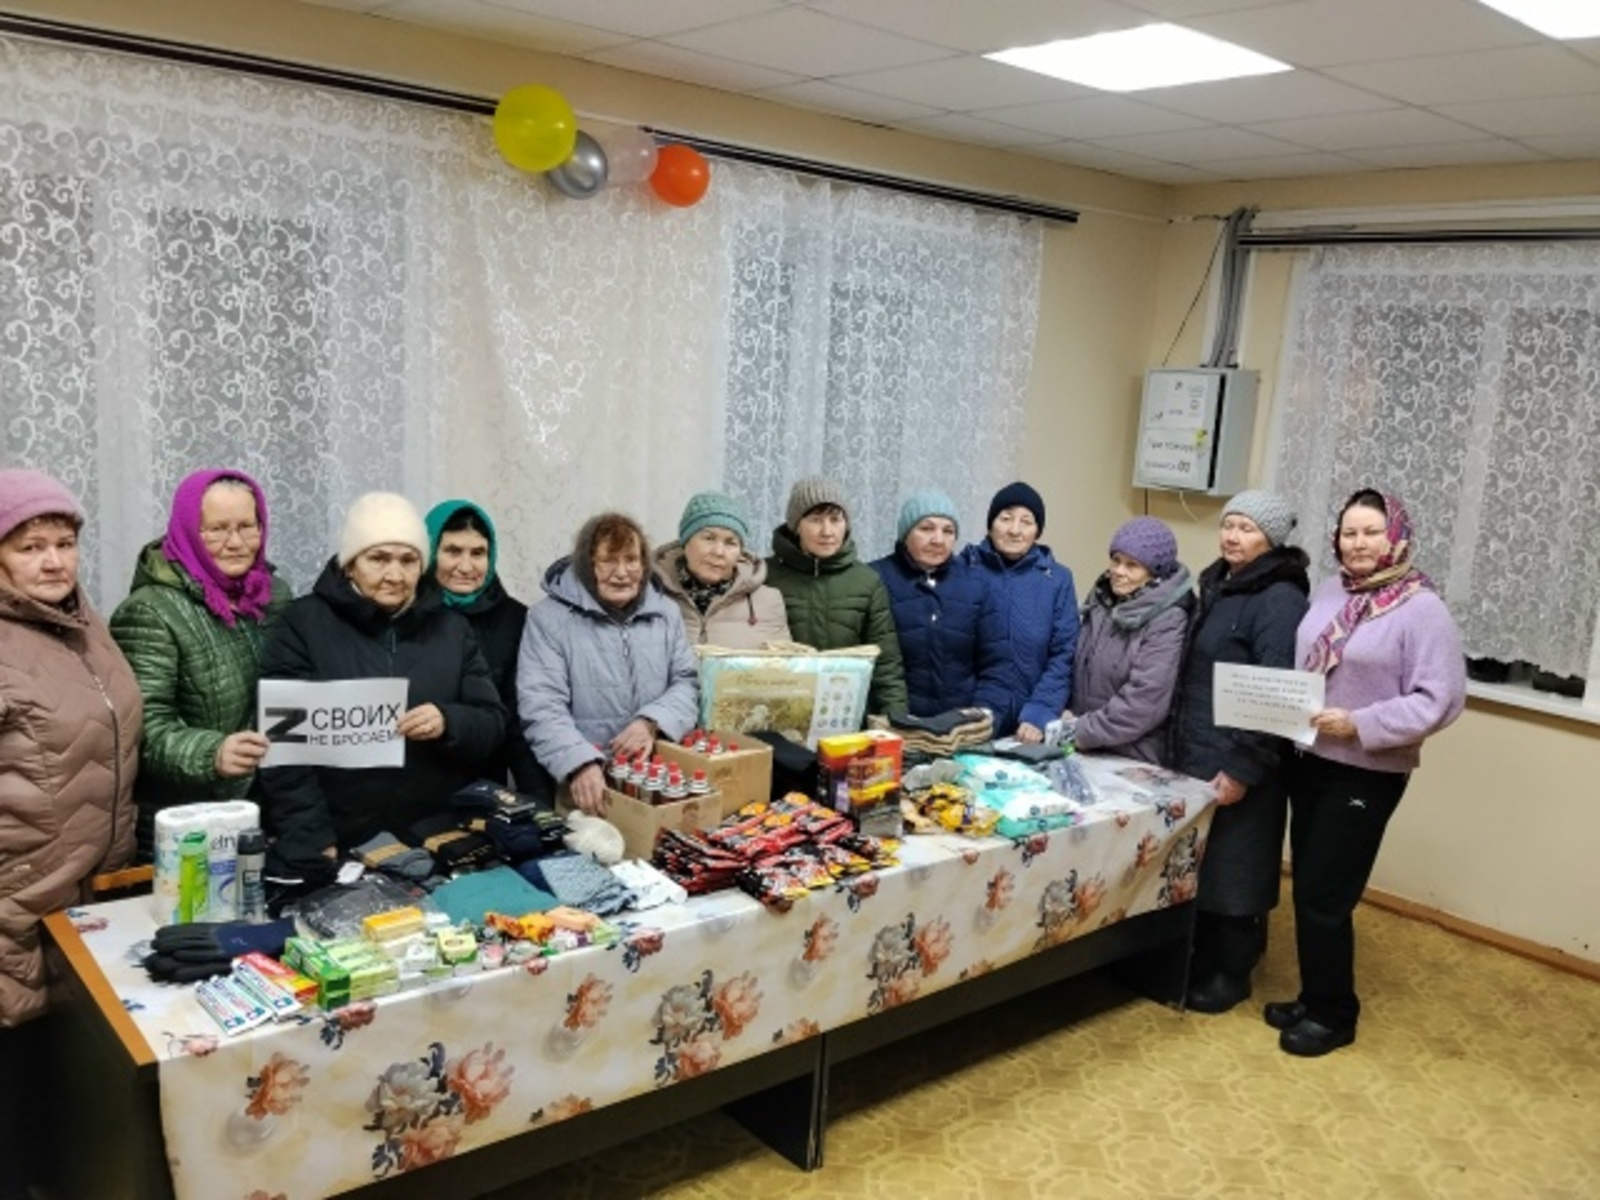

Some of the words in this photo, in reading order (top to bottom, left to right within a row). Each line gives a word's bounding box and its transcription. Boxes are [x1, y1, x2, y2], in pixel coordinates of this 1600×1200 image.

[265, 707, 308, 743] Z
[311, 702, 400, 730] СВОИХ
[310, 733, 328, 746] НЕ
